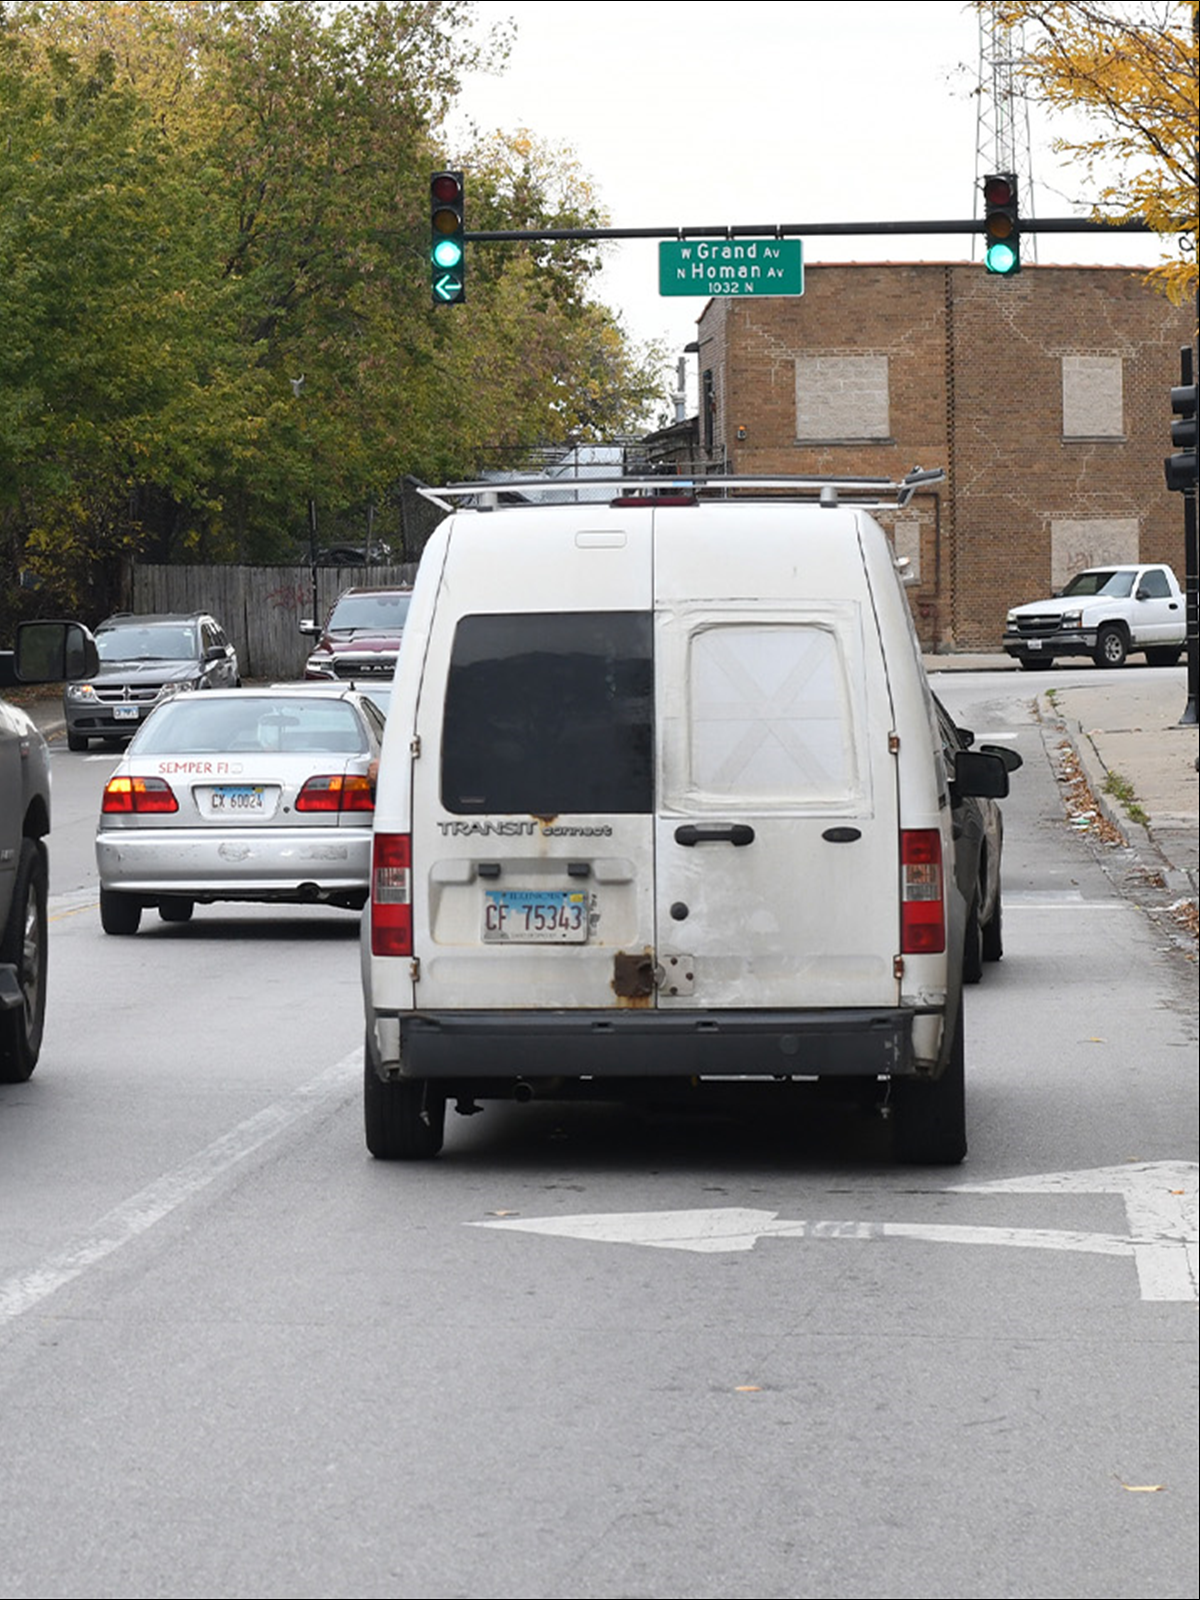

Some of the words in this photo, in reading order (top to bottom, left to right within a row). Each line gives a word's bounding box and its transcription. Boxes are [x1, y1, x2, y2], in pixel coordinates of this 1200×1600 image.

[680, 248, 691, 259] W
[697, 243, 757, 259] Grand
[763, 247, 780, 258] Av
[677, 268, 686, 279] N
[691, 263, 761, 279] Homan
[766, 267, 784, 278] Av
[708, 282, 739, 293] 1032
[744, 282, 754, 293] N
[158, 762, 213, 774] SEMPER
[211, 793, 226, 808] CX
[437, 821, 538, 836] TRANSIT
[486, 905, 509, 931] CF
[522, 905, 582, 931] 75343
